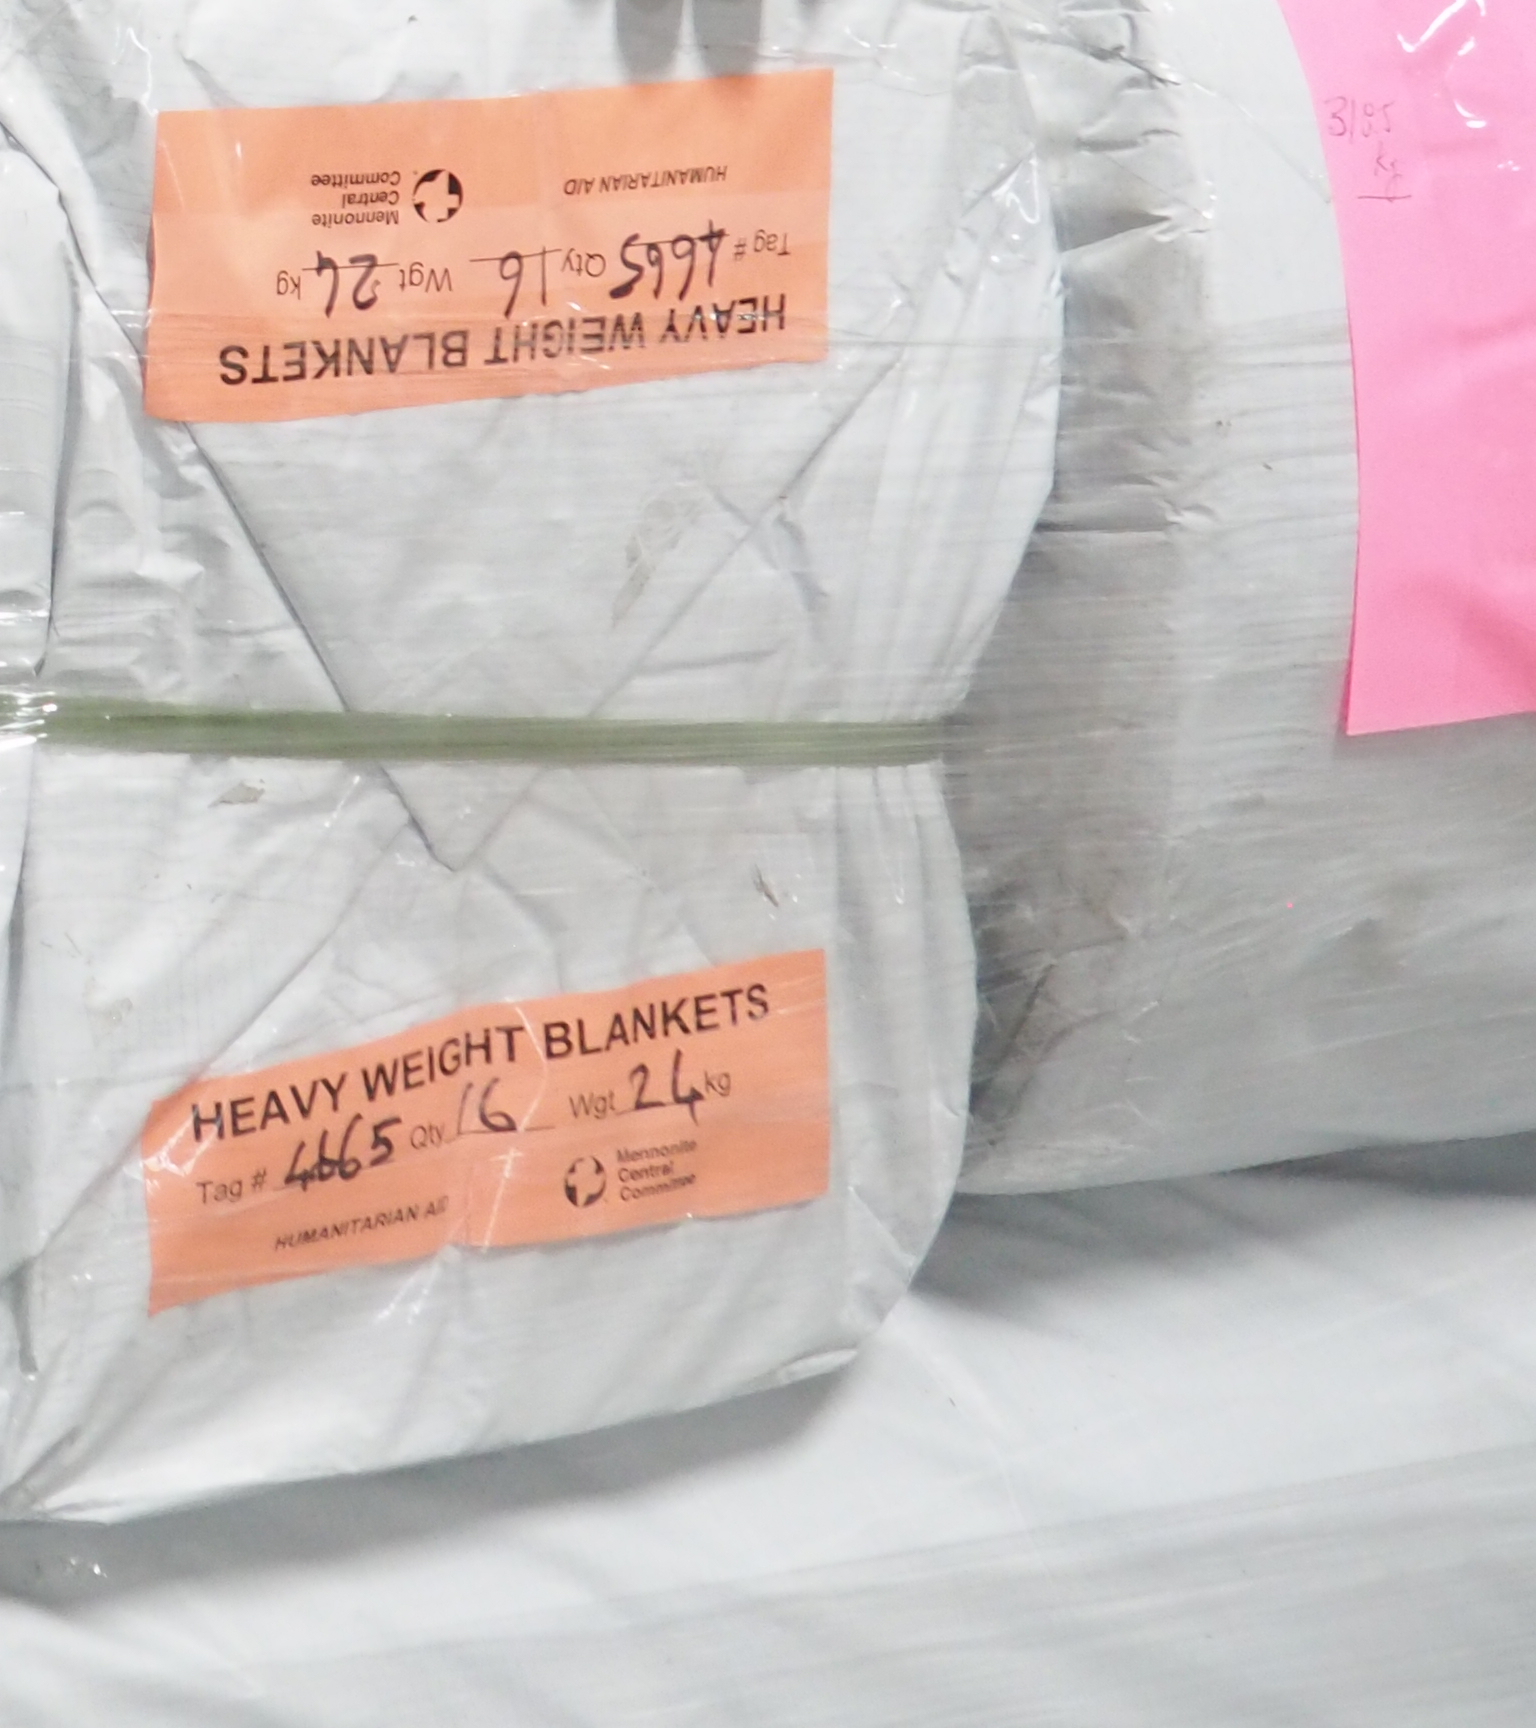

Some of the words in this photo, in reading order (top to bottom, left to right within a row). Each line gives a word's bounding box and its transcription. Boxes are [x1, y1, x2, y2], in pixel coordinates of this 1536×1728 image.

[310, 170, 401, 189] Committee
[563, 176, 594, 196] AID
[599, 165, 728, 192] HUMANITARIAN
[341, 191, 400, 209] Central
[310, 211, 400, 229] Mennonite
[754, 229, 790, 257] Tag
[561, 248, 606, 279] Qty
[608, 221, 730, 300] 4665
[276, 271, 302, 299] kg
[315, 251, 381, 318] 24
[398, 264, 452, 293] Wgt
[498, 247, 549, 318] 16
[660, 293, 786, 345] HEAVY
[484, 311, 647, 366] WEIGHT
[218, 329, 469, 386] BLANKETS
[191, 1070, 357, 1143] HEAVY
[361, 1025, 524, 1102] WEIGHT
[544, 983, 770, 1060] BLANKETS
[196, 1179, 245, 1208] Tag
[284, 1112, 402, 1191] 4665
[410, 1122, 444, 1152] Qty
[458, 1076, 517, 1133] 16
[569, 1091, 616, 1119] Wgt
[628, 1049, 704, 1123] 24
[704, 1072, 731, 1097] kg
[616, 1138, 698, 1164] Mennonite
[618, 1161, 675, 1183] Central
[618, 1174, 698, 1203] Committee
[273, 1206, 418, 1251] HUMANITARIAN
